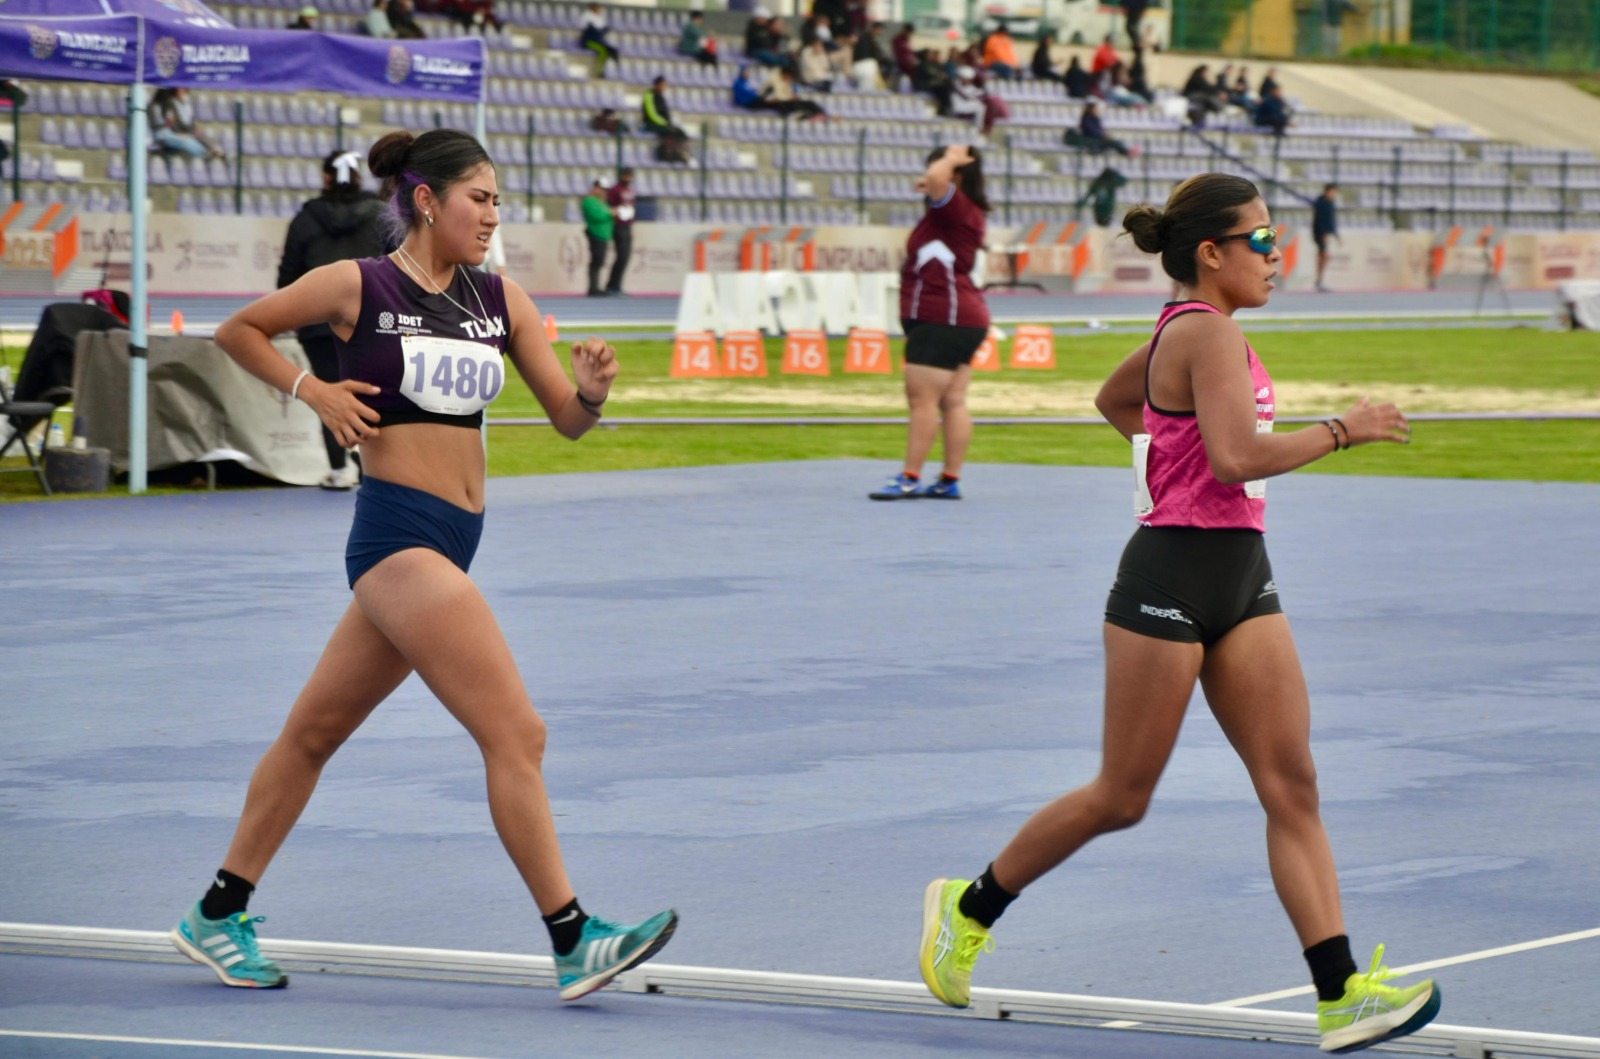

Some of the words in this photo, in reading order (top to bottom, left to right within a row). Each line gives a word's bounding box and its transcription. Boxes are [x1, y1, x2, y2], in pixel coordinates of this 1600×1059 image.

[81, 231, 164, 252] TLAXCLA
[397, 313, 423, 328] IDET
[459, 315, 507, 339] TLAX
[678, 344, 711, 371] 14
[725, 344, 760, 372] 15
[789, 342, 823, 369] 16
[850, 341, 884, 368] 17
[975, 340, 993, 366] 9
[1016, 336, 1053, 363] 20
[409, 351, 502, 402] 1480
